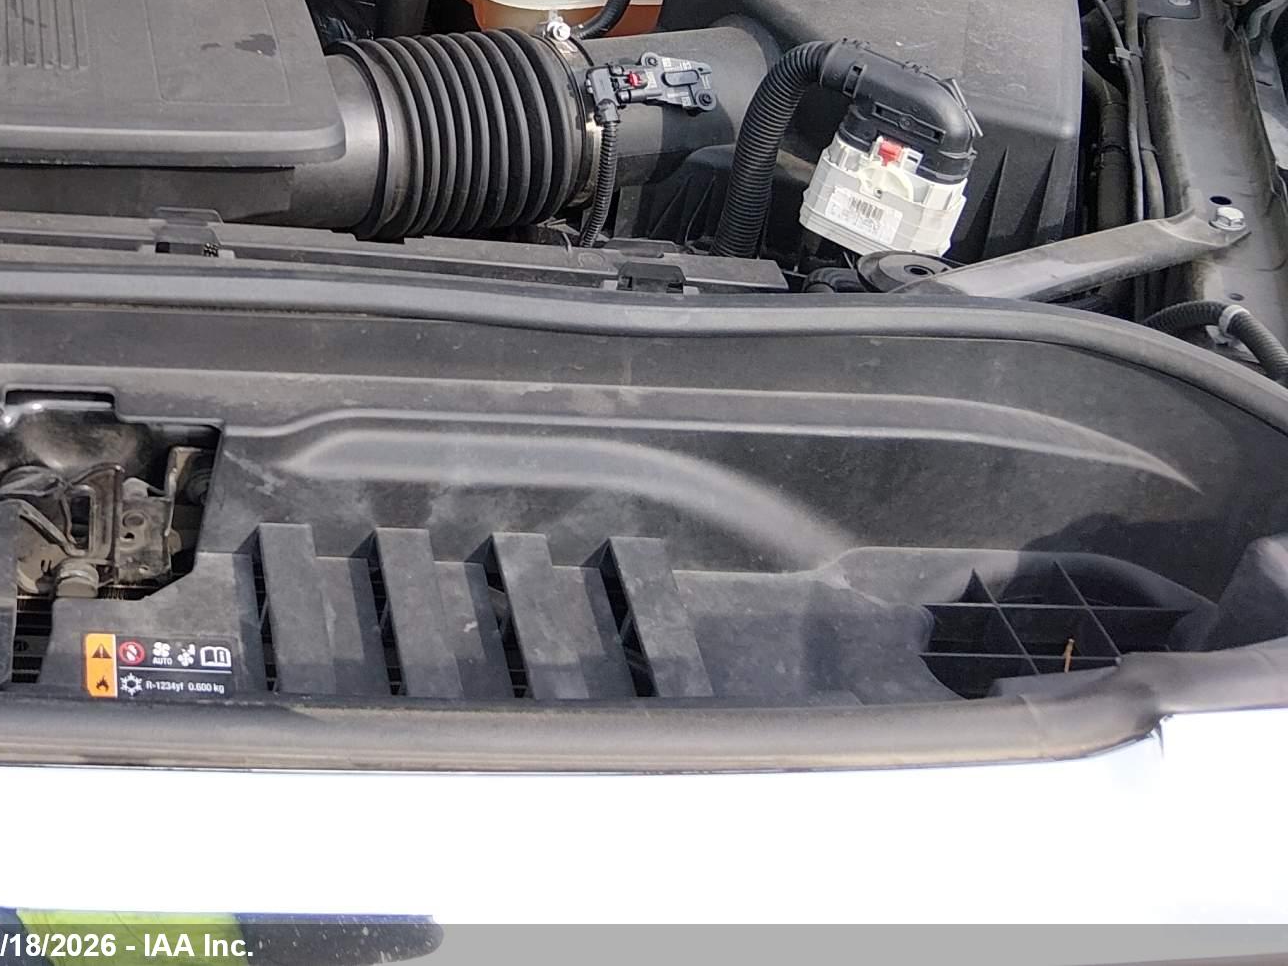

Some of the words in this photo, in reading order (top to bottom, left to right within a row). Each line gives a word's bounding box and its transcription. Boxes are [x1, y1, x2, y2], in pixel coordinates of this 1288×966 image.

[152, 656, 173, 666] AUTO
[145, 680, 184, 692] R-1234yf
[213, 683, 225, 694] kg
